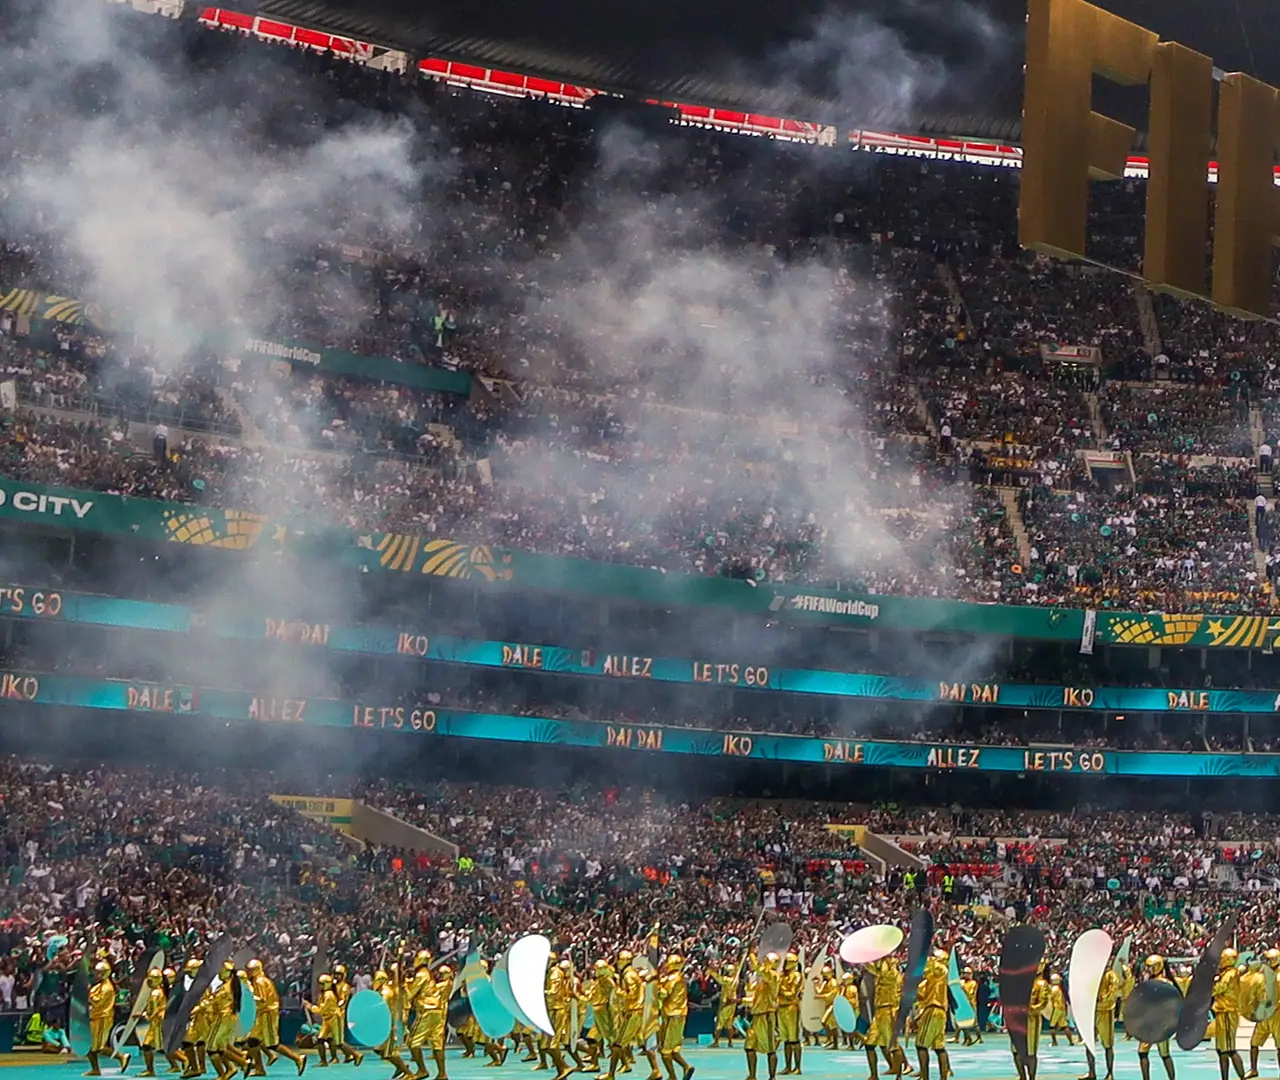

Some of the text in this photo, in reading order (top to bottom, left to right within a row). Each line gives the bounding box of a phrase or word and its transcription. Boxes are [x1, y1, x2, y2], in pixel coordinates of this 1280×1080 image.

[13, 491, 93, 518] CITY
[32, 592, 61, 615] GO
[794, 595, 879, 619] #FIFAWorldCup
[397, 633, 428, 656] IKO
[502, 645, 543, 668] DALE
[603, 655, 653, 677] ALLEZ
[693, 662, 768, 685] LET'S GO
[0, 674, 38, 700] IKO
[939, 681, 998, 702] DAI DAI
[1063, 687, 1093, 706] IKO
[127, 688, 174, 711] DALE
[249, 697, 306, 720] ALLEZ
[1168, 691, 1209, 710] DALE
[354, 705, 436, 731] LET'S GO
[606, 726, 663, 749] DAI DAI
[723, 734, 752, 756] IKO
[823, 741, 865, 762] DALE
[927, 747, 979, 768] ALLEZ
[1024, 750, 1104, 771] LET'S GO
